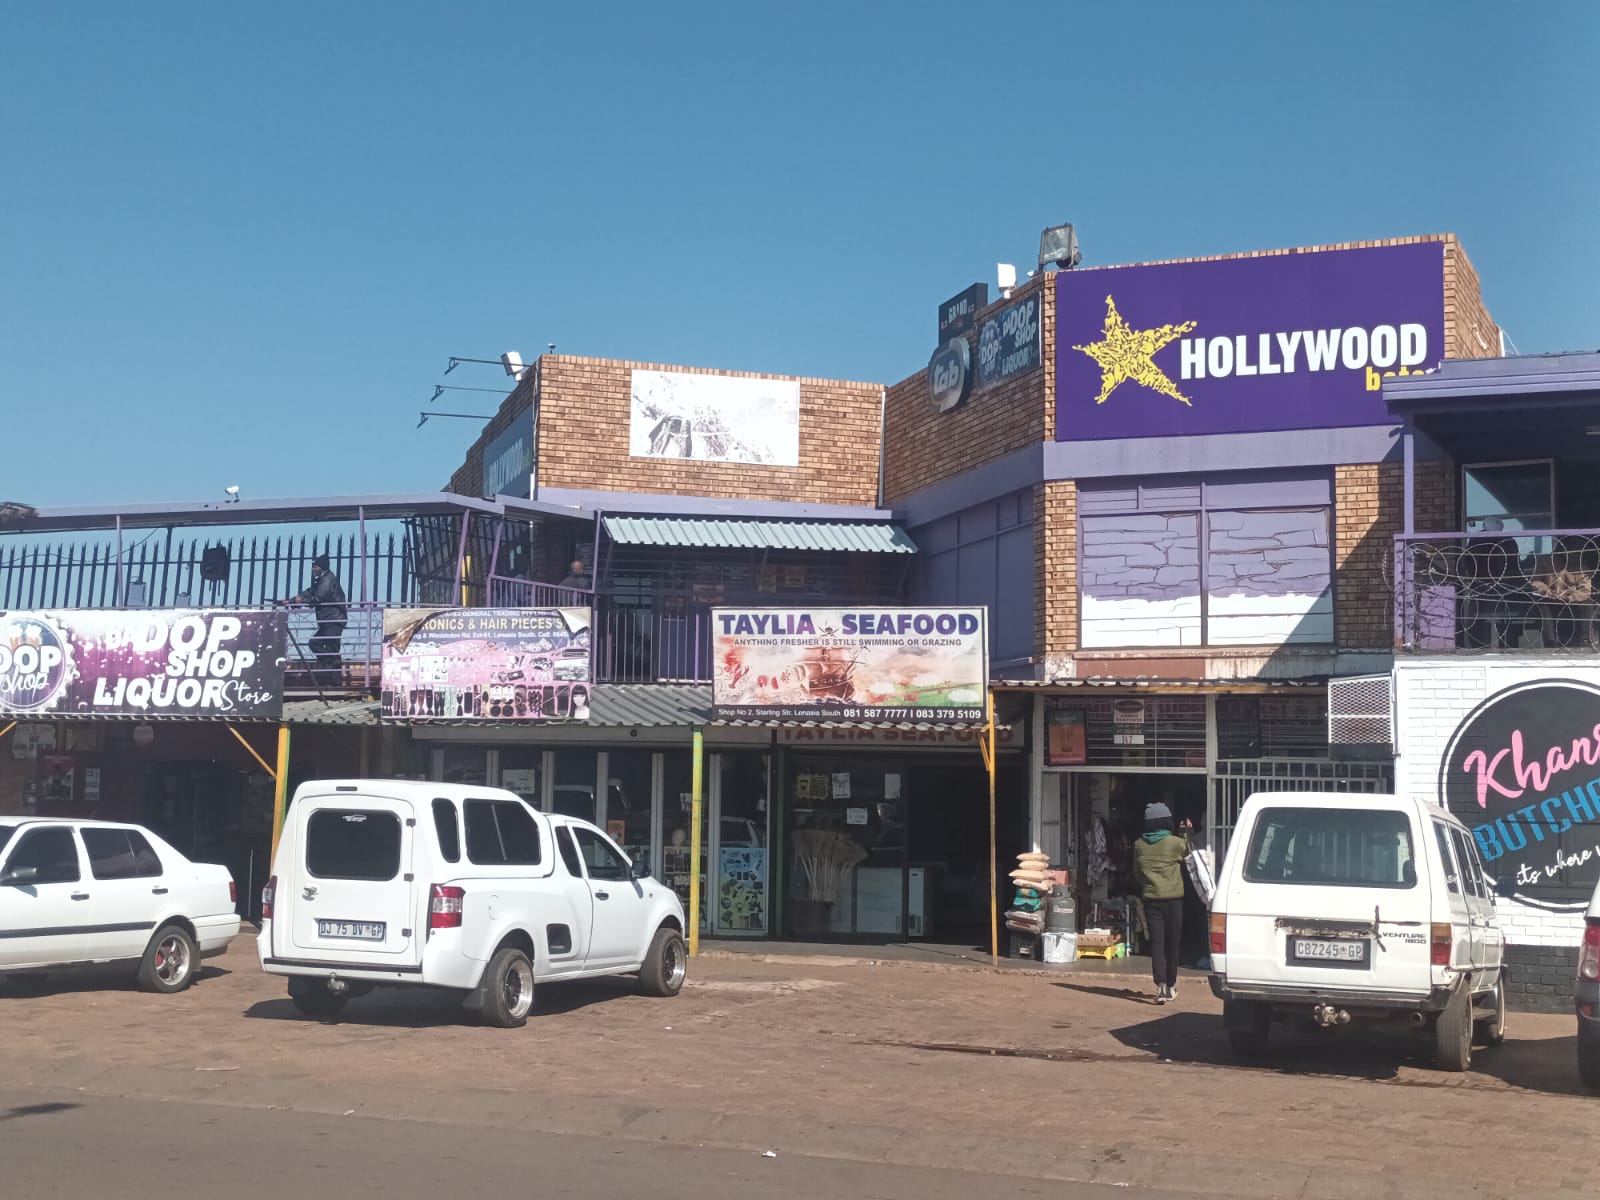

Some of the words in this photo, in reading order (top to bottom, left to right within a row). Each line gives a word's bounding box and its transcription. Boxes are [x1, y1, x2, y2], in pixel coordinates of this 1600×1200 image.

[1014, 322, 1037, 349] SHOP
[1180, 323, 1427, 380] HOLLYWOOD
[934, 360, 960, 395] tab
[421, 619, 464, 630] RONICS
[468, 619, 476, 630] &
[480, 618, 508, 630] HAIR
[511, 618, 552, 629] PIECES
[718, 614, 816, 635] TAYLIA
[842, 614, 979, 635] SEAFOOD
[165, 650, 255, 677] SHOP
[93, 677, 226, 709] LIQUOR
[221, 680, 272, 710] Store
[718, 709, 736, 717] Shop
[756, 709, 780, 717] Starling
[822, 709, 841, 717] South
[844, 709, 860, 717] 081
[864, 709, 880, 717] 587
[884, 709, 907, 718] 7777
[916, 709, 933, 718] 083
[937, 709, 954, 718] 379
[957, 710, 981, 719] 5109
[1545, 849, 1592, 877] where
[321, 922, 331, 934] DJ
[336, 923, 347, 935] 75
[371, 924, 382, 936] GP
[1382, 931, 1426, 939] VENTURE
[1348, 944, 1362, 958] GP
